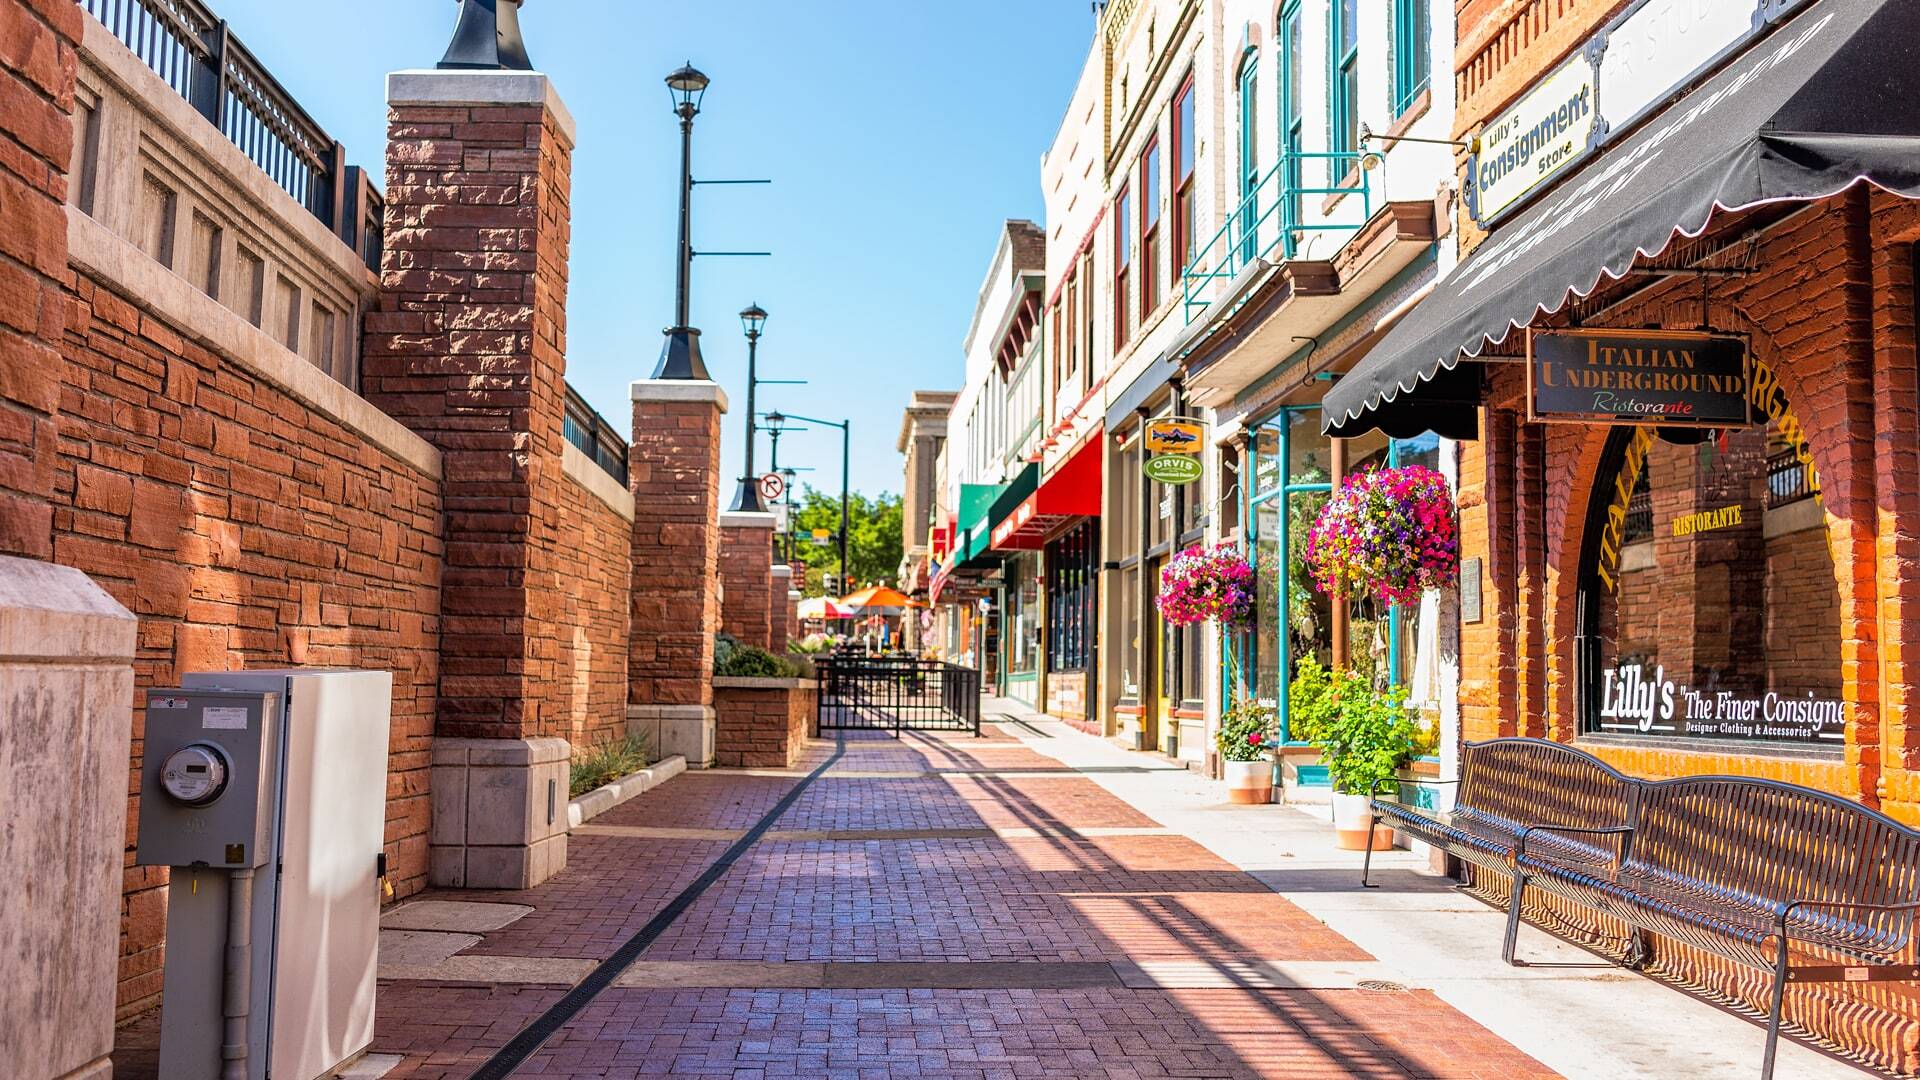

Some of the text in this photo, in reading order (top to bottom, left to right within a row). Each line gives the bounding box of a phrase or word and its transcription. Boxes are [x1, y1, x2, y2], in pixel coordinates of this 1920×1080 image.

[1489, 115, 1519, 149] Lilly's
[1538, 140, 1573, 175] Store
[1586, 339, 1696, 369] ITALIAN
[1543, 361, 1742, 394] UNDERGROUND
[1592, 391, 1693, 415] Ristorante
[1153, 459, 1193, 470] ORVIS
[1597, 415, 1664, 593] ITALIA
[1672, 504, 1742, 537] RISTORANTE
[1601, 664, 1675, 732] Lilly's
[1715, 691, 1760, 721] Finer
[1685, 721, 1812, 737] Designer Clothing & Accessories
